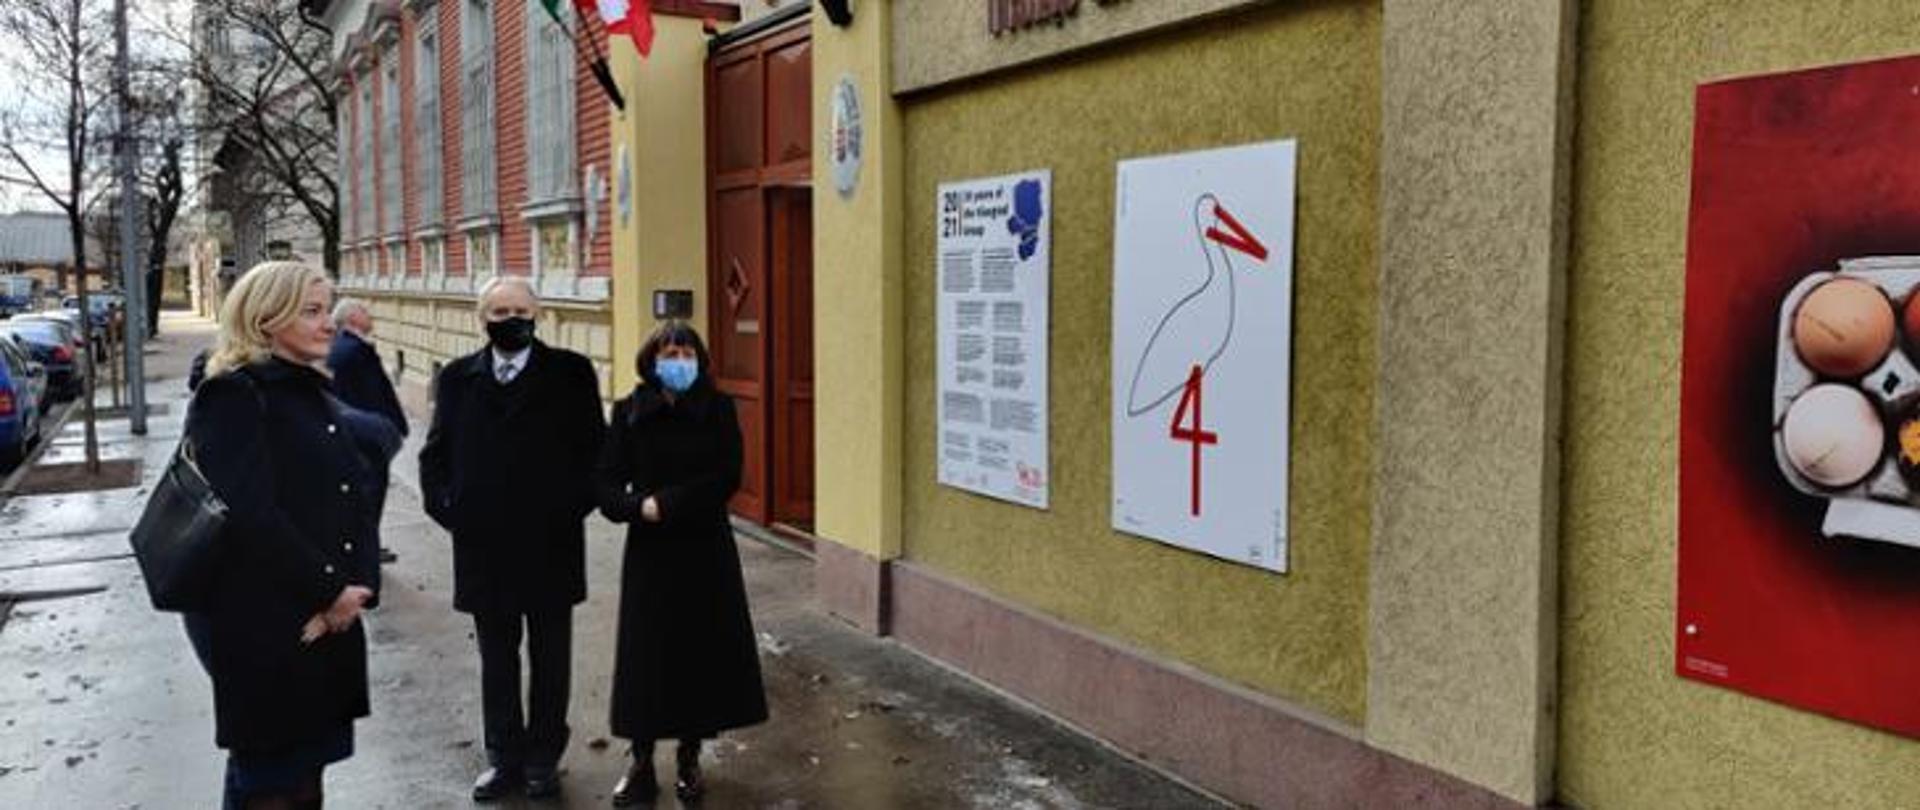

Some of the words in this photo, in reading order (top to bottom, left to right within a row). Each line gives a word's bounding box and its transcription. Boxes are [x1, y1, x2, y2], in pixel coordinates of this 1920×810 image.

[944, 191, 957, 212] 20
[943, 217, 957, 238] 21
[1170, 365, 1218, 516] 4
